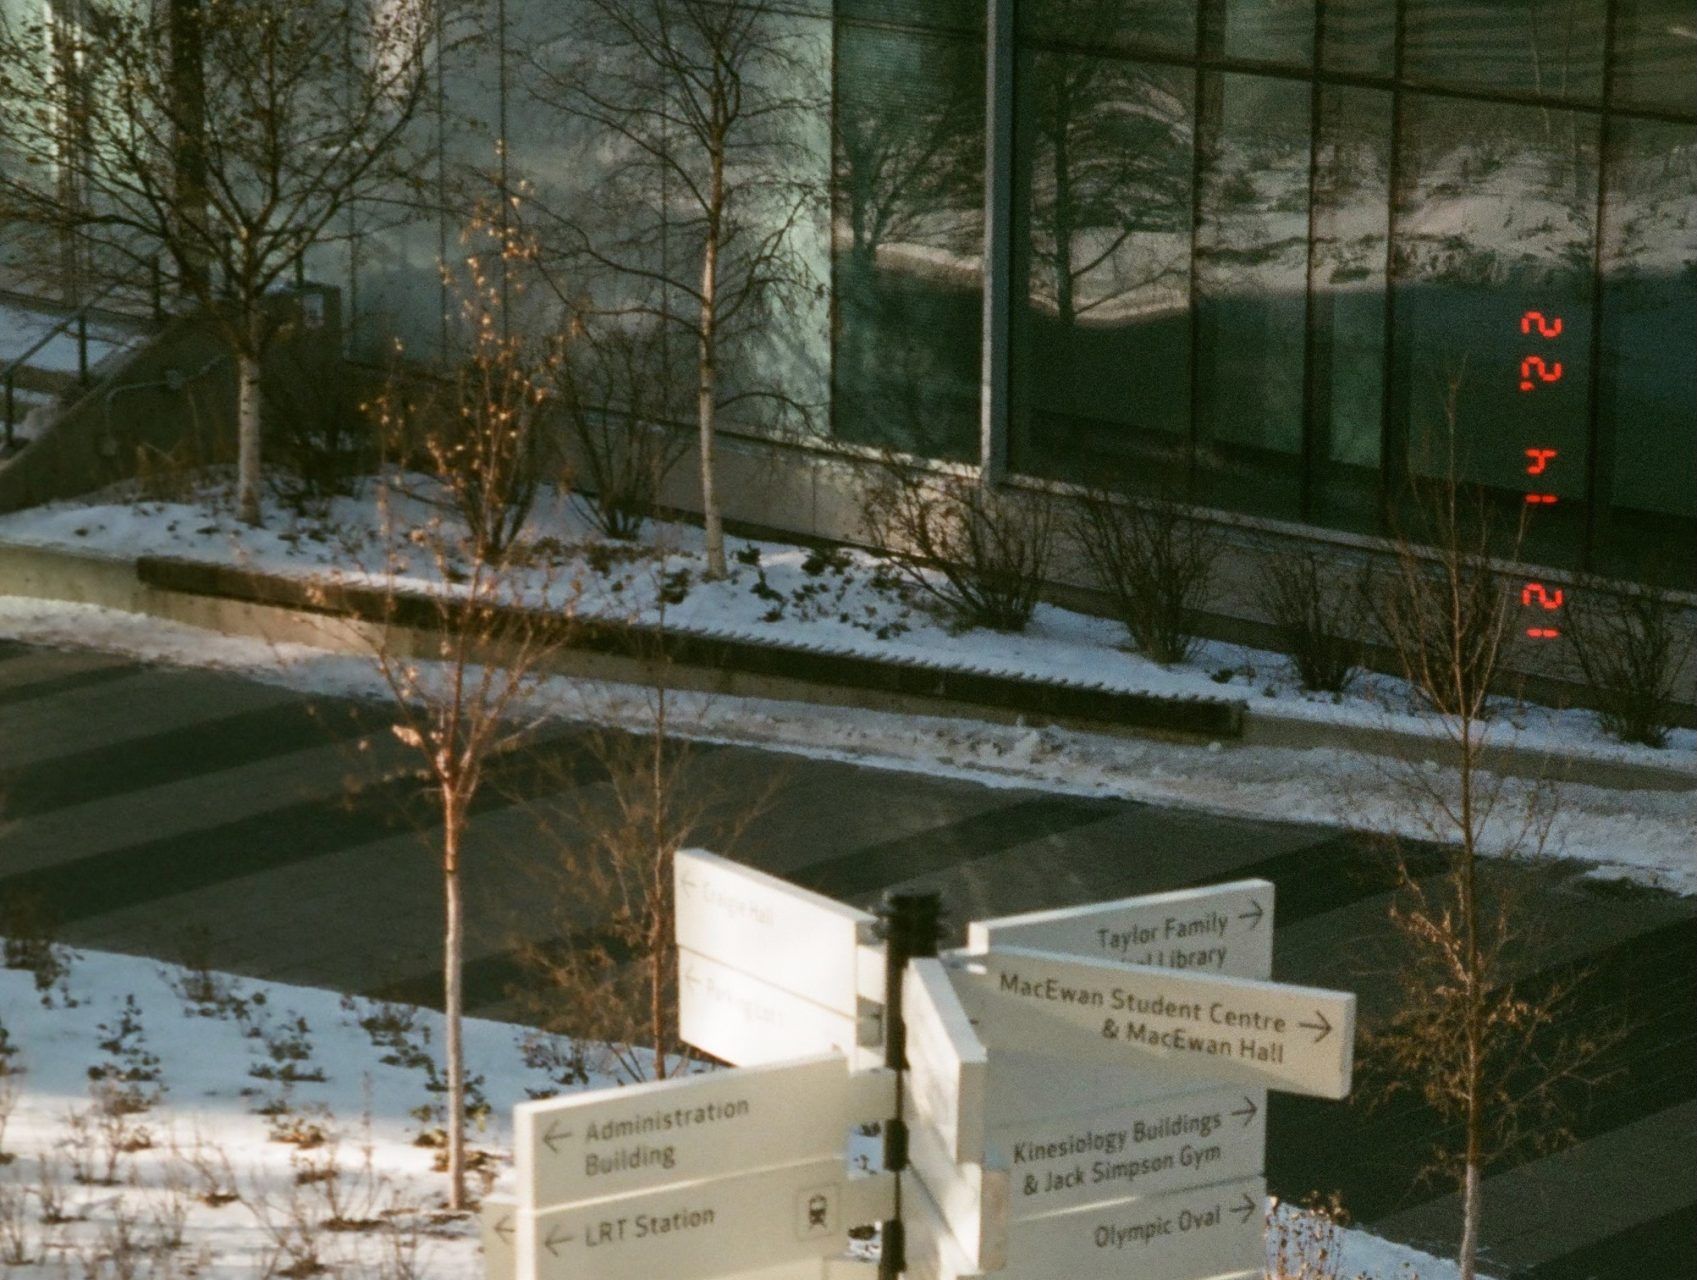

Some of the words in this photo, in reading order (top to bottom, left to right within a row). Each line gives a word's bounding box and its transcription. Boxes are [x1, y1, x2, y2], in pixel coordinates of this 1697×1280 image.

[1096, 923, 1157, 952] Taylor
[1164, 912, 1228, 940] Family
[1000, 972, 1104, 1007] MacEwan
[1111, 988, 1202, 1021] Student
[1209, 1003, 1286, 1033] Centre
[1101, 1018, 1119, 1040] &
[1126, 1021, 1232, 1057] MacEwan
[1240, 1037, 1284, 1065] Hall
[584, 1099, 750, 1143] Administration
[1013, 1129, 1128, 1164] Kinesiology
[1132, 1113, 1222, 1144] Buildings
[585, 1145, 676, 1177] Building
[1023, 1174, 1039, 1196] &
[1044, 1166, 1086, 1193] Jack
[1091, 1152, 1174, 1184] Simpson
[1179, 1143, 1222, 1170] Gym
[585, 1217, 627, 1248] LRT
[635, 1208, 715, 1239] Station
[1094, 1215, 1172, 1249] Olympic
[1179, 1204, 1221, 1232] Oval
